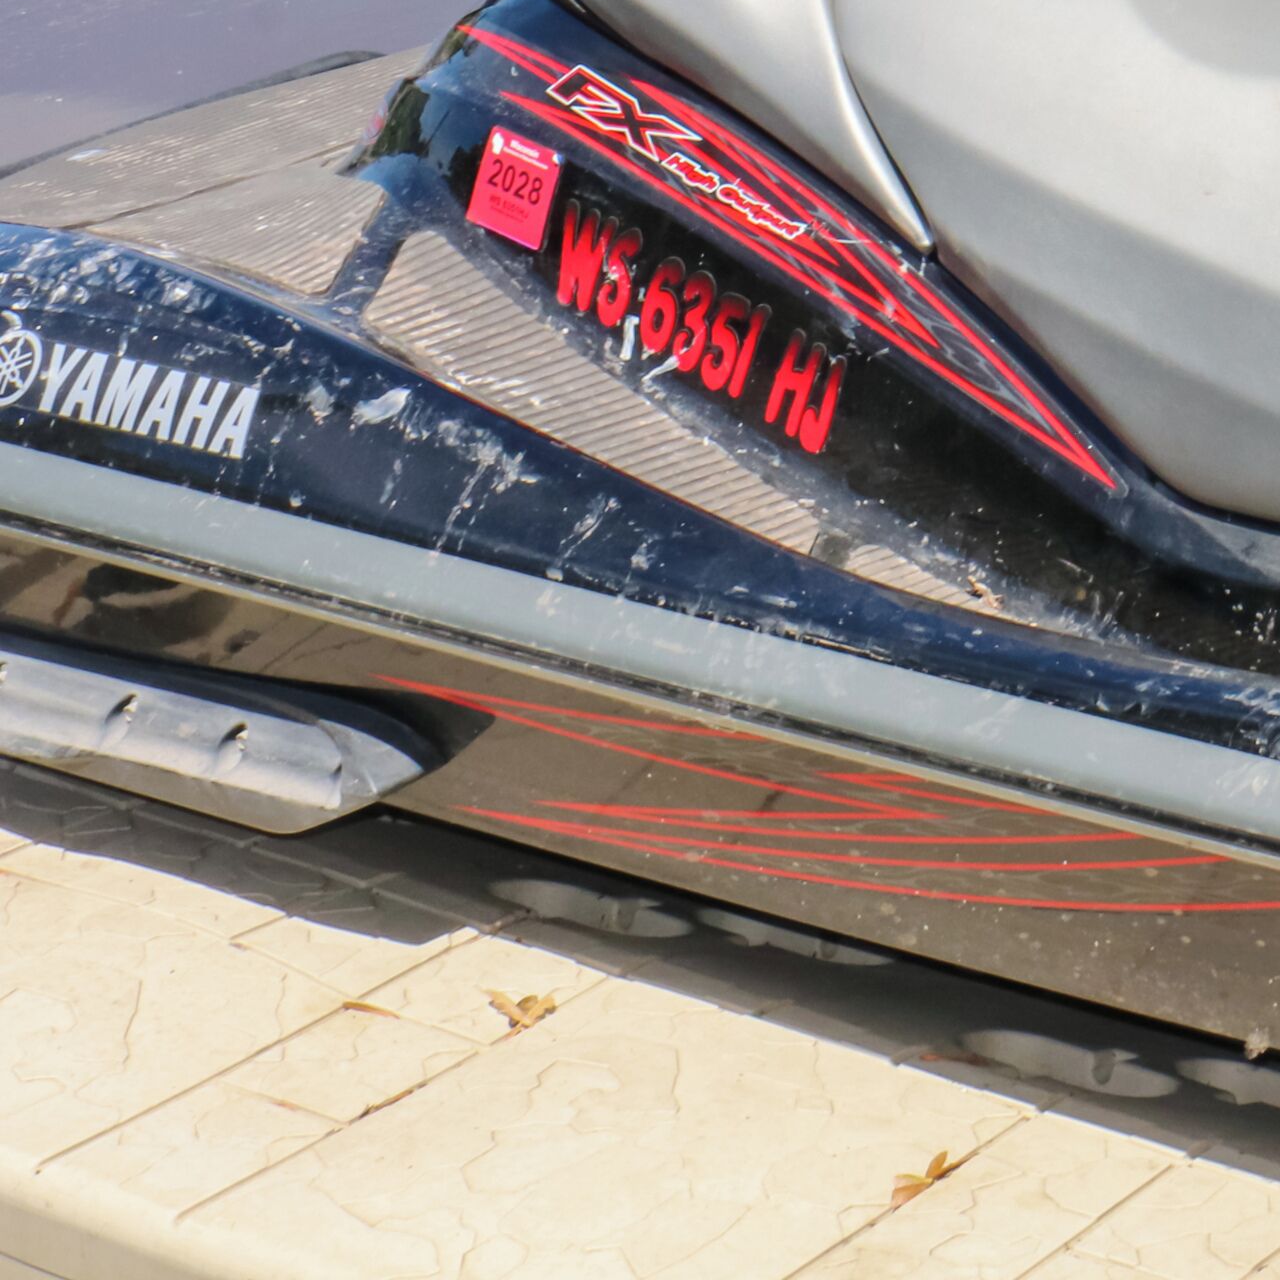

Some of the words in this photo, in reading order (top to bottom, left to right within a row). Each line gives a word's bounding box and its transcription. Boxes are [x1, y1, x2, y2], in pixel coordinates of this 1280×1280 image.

[545, 64, 703, 162] FX
[487, 158, 544, 206] 2028
[660, 152, 720, 193] High
[716, 182, 807, 240] Output
[556, 198, 644, 328] WS
[639, 256, 773, 399] 6351
[764, 327, 848, 455] HJ
[37, 342, 261, 460] YAMAHA
